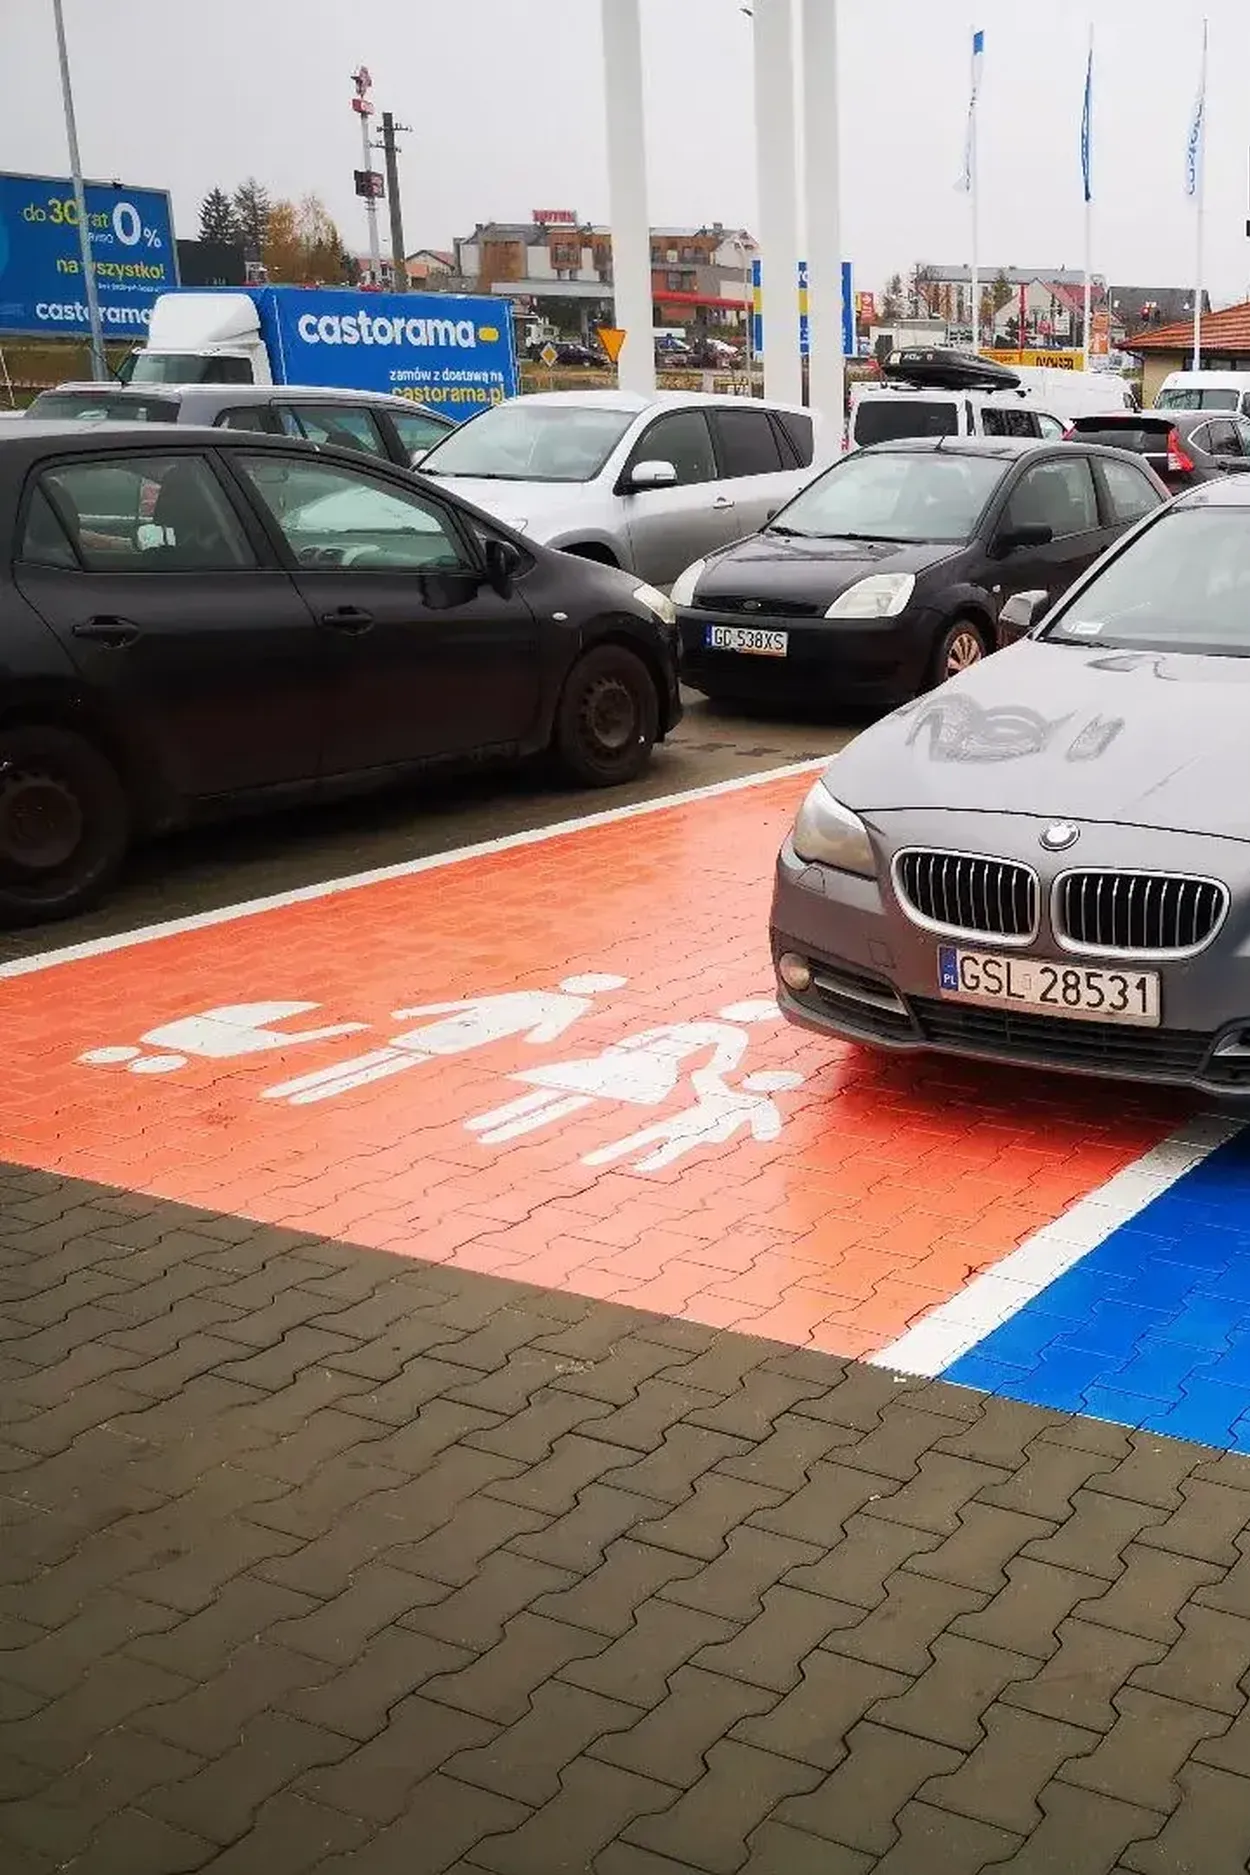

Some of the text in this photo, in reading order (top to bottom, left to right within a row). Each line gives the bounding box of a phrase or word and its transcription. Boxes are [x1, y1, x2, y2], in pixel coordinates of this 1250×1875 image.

[23, 204, 46, 222] do
[48, 198, 82, 225] 30
[57, 258, 79, 274] na
[298, 310, 476, 348] castorama
[390, 367, 504, 384] zamów z dostawą na
[391, 384, 505, 405] castorama.pl
[714, 628, 784, 650] GD 538XS
[943, 973, 957, 986] PL
[960, 955, 1148, 1014] GSL 28531
